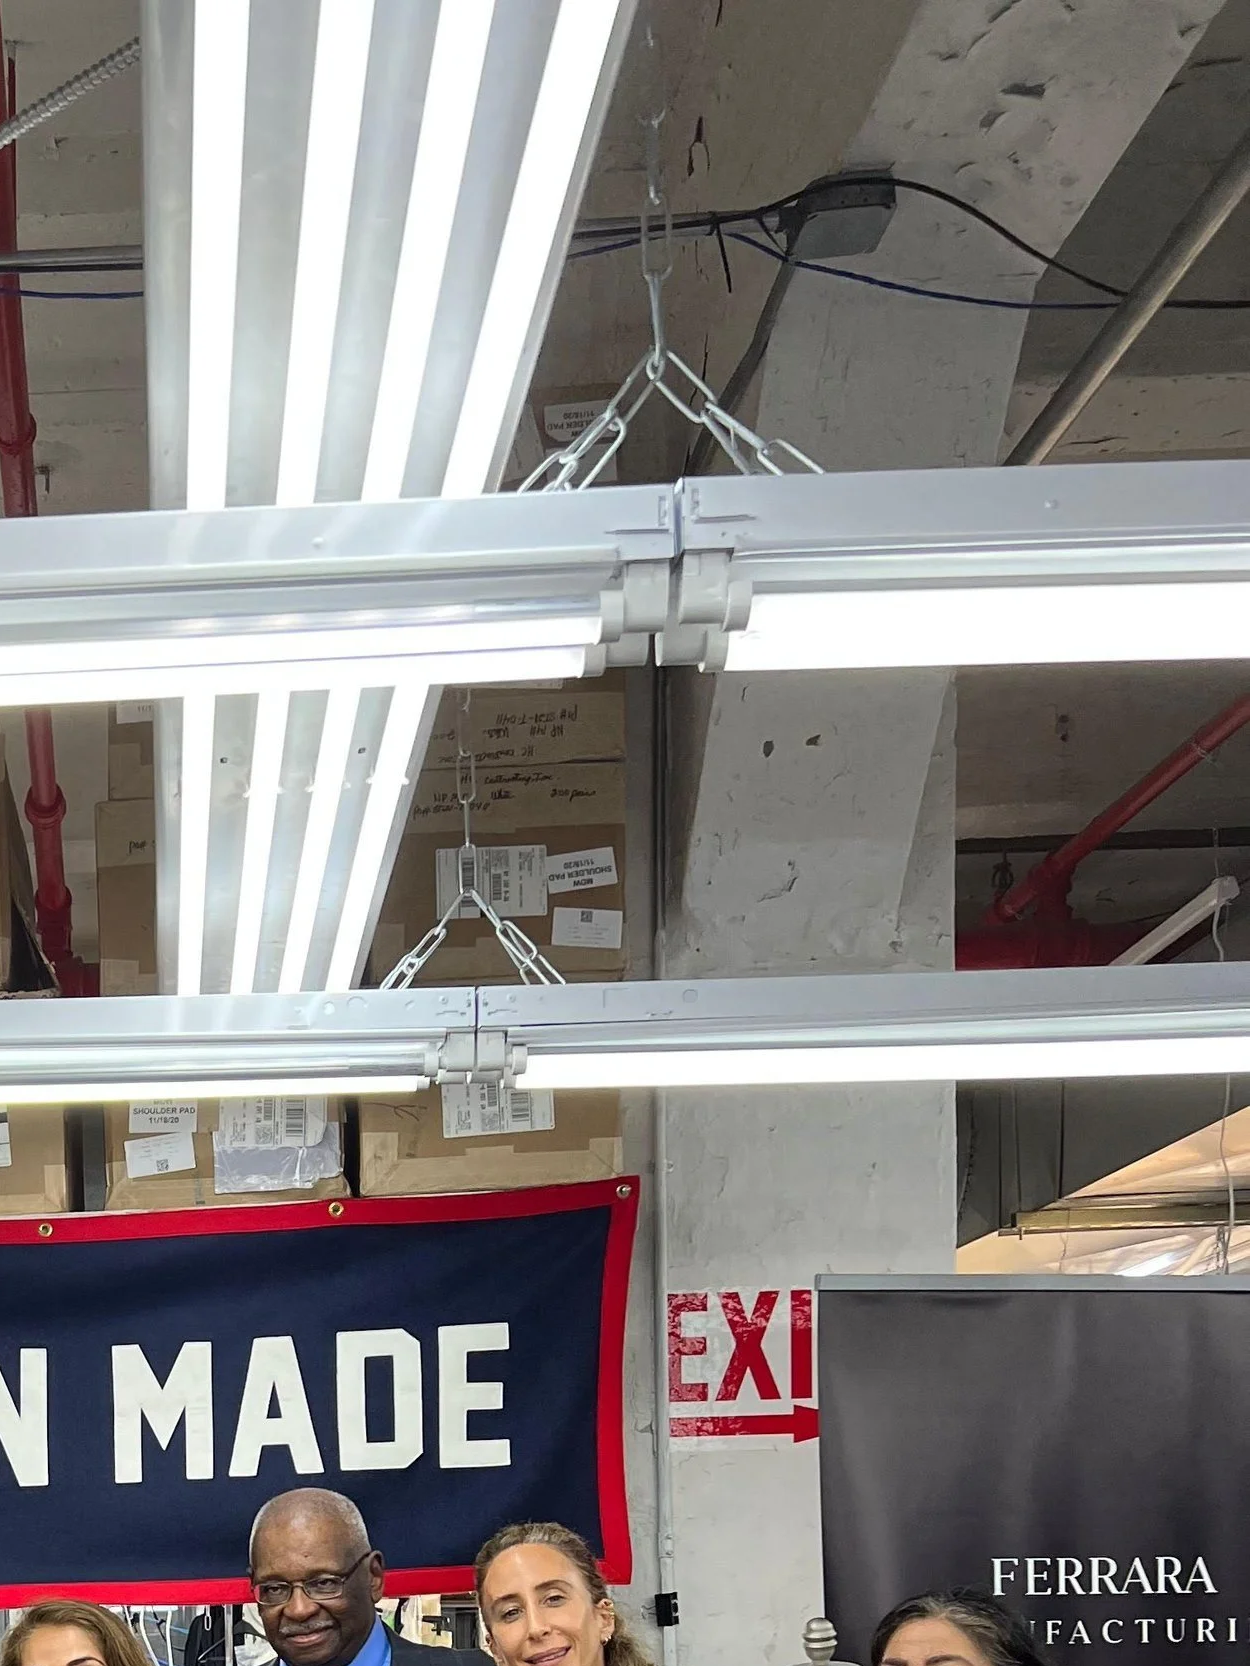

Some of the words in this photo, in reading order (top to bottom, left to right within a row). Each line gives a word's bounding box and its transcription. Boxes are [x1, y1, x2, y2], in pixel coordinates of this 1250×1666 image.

[548, 873, 565, 882] PAD
[568, 865, 612, 879] SHOULDER
[133, 1106, 177, 1115] SHOULDER
[179, 1106, 196, 1115] PAD
[667, 1289, 813, 1402] EXI
[111, 1321, 513, 1484] MADE
[991, 1555, 1219, 1597] FERRARA
[1028, 1616, 1250, 1646] FACTURI
